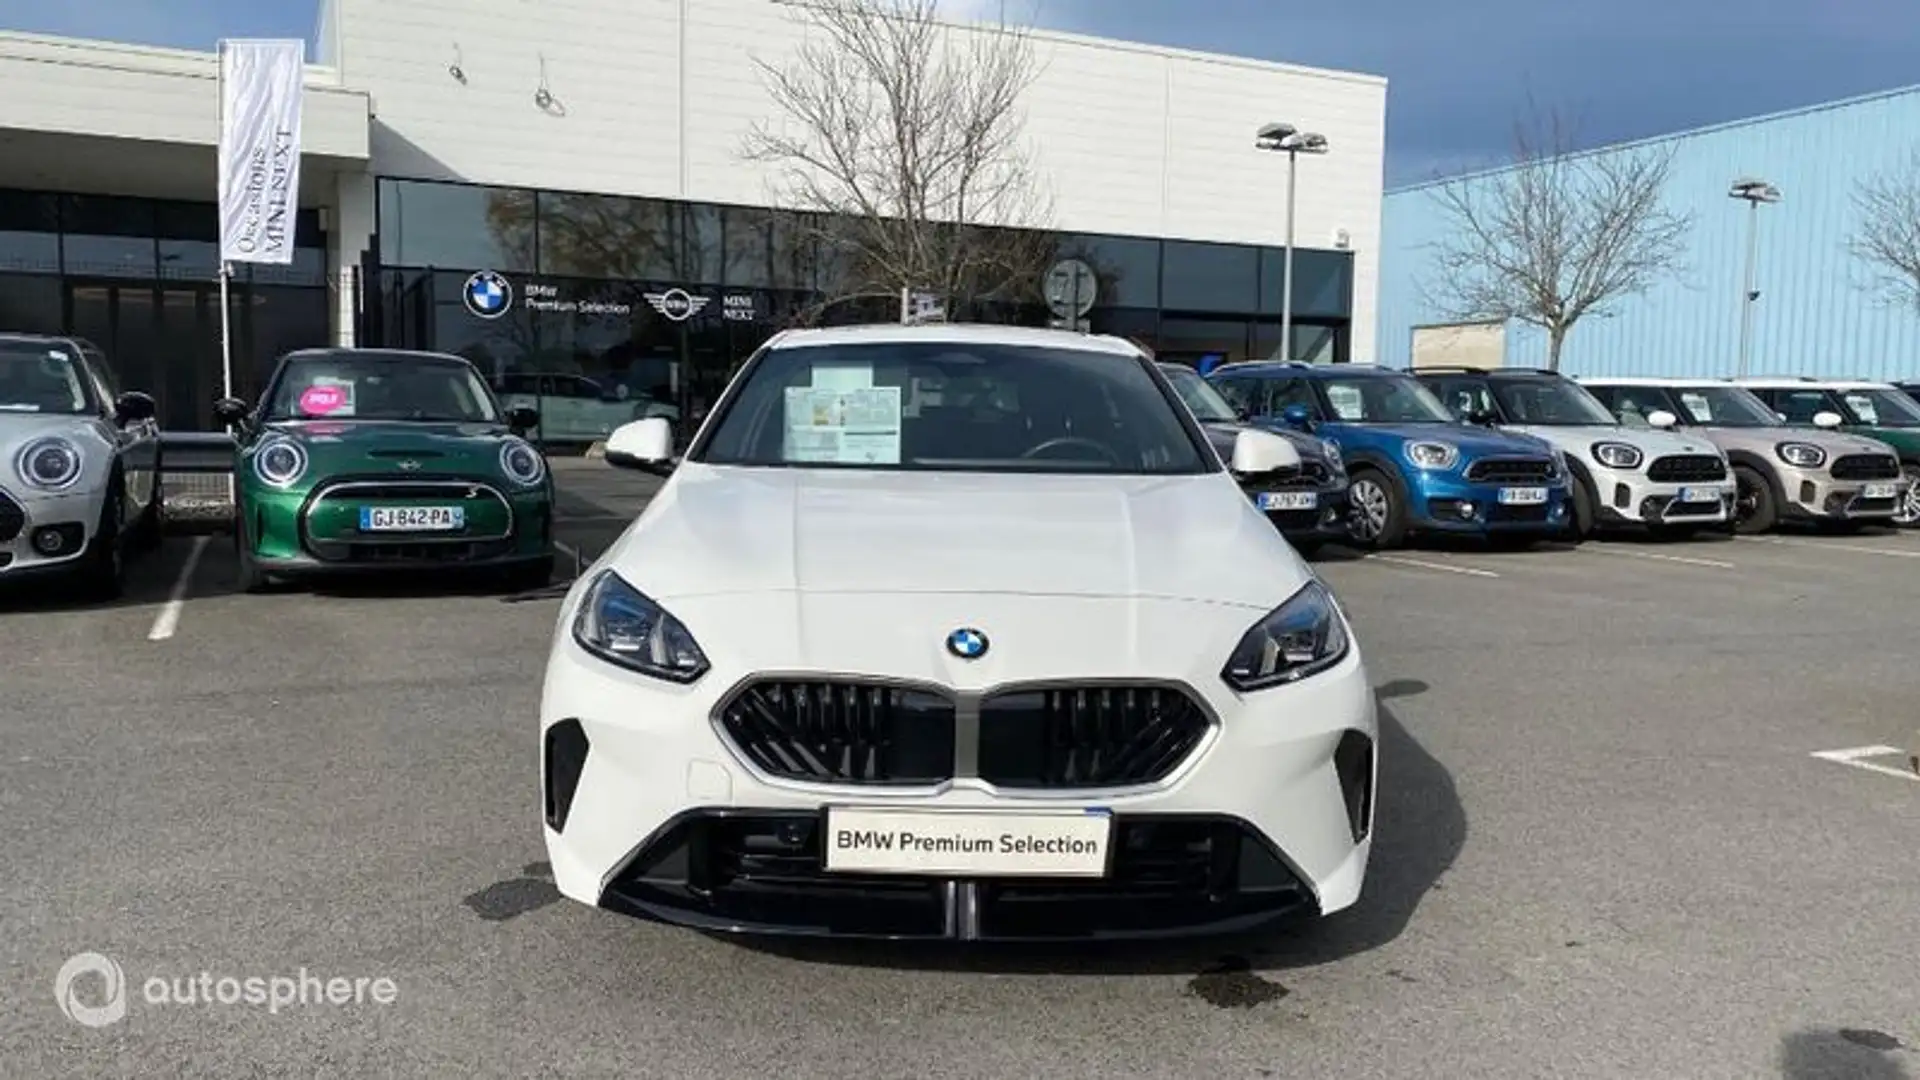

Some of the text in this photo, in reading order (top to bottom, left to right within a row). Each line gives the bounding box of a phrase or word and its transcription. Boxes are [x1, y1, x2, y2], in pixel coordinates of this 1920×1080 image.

[525, 298, 632, 315] Premium Selection
[836, 830, 1098, 854] BMW Premium Selection
